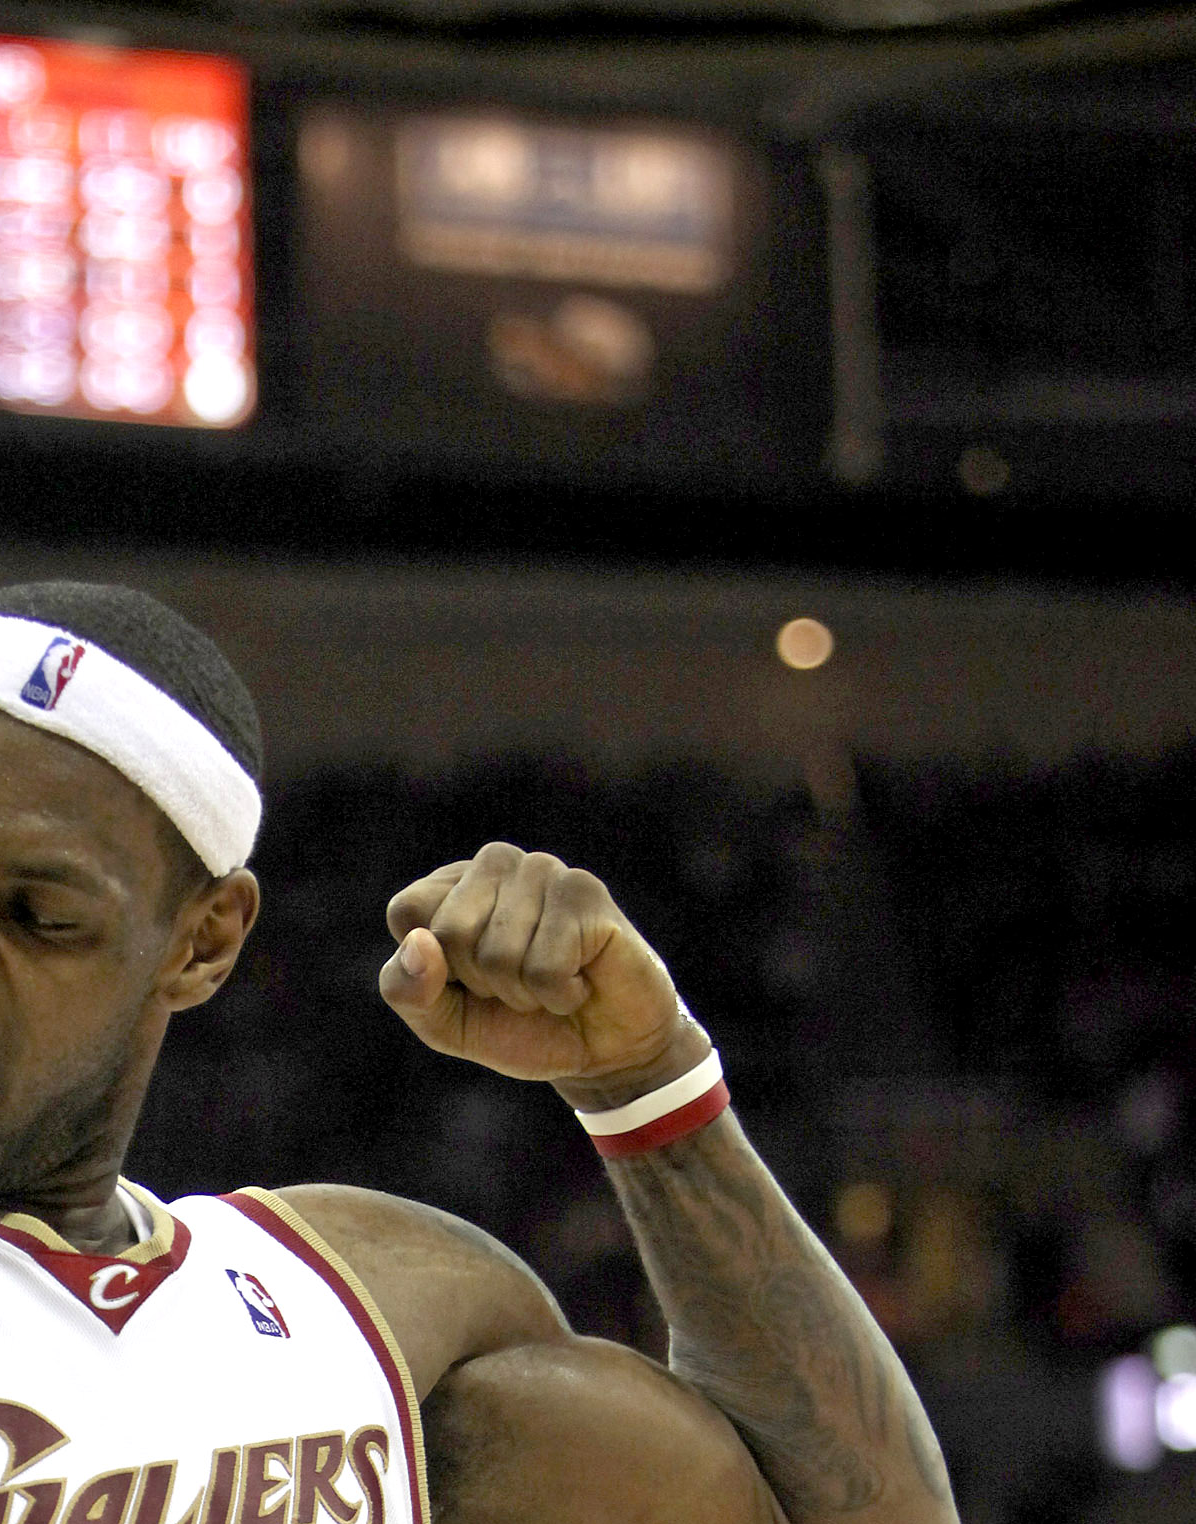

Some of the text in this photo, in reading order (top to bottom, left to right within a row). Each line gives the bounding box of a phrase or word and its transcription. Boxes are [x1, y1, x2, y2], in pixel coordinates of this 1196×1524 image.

[24, 683, 50, 704] NBA
[88, 1263, 140, 1310] C
[255, 1320, 279, 1334] NBA
